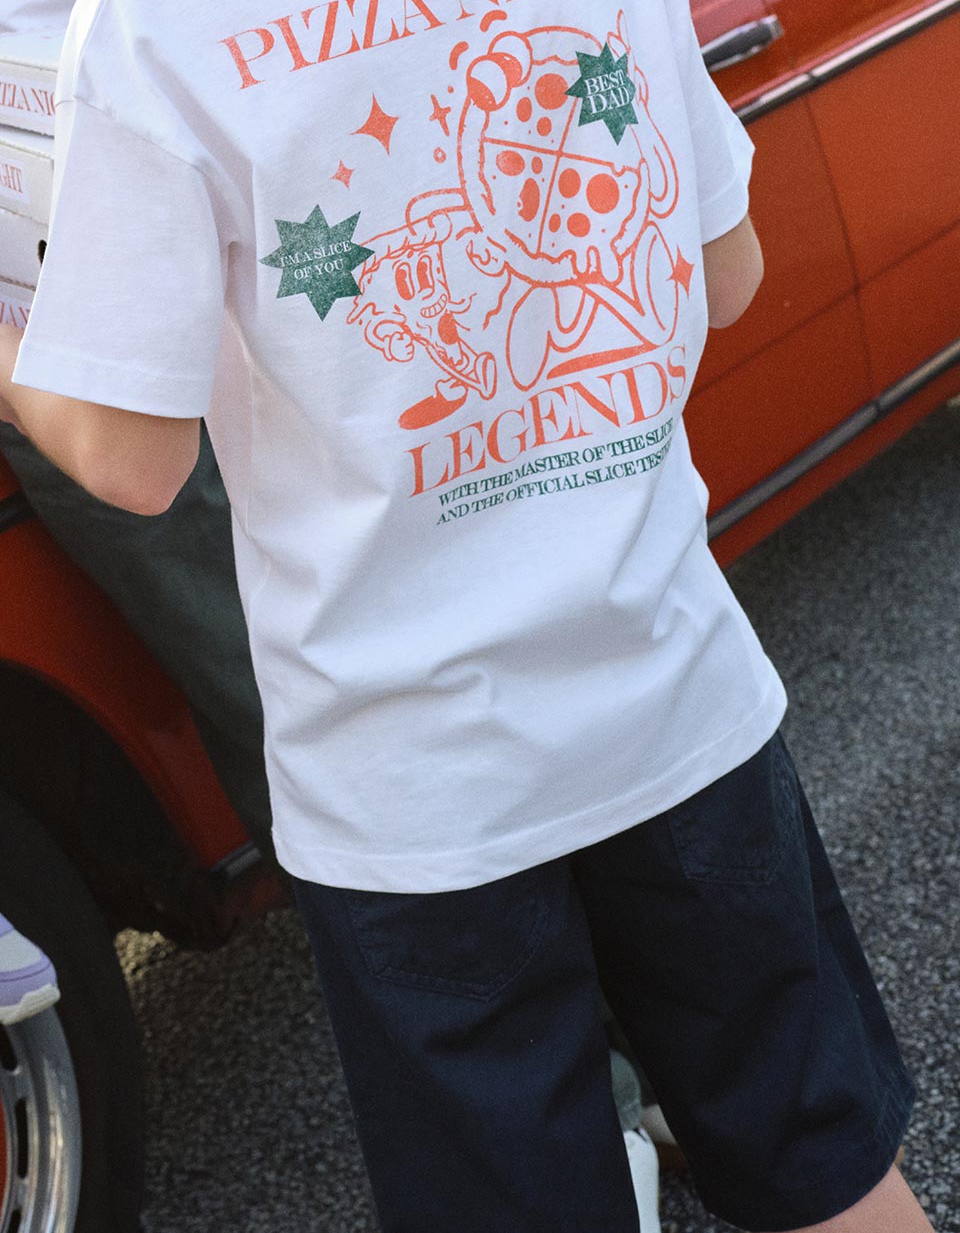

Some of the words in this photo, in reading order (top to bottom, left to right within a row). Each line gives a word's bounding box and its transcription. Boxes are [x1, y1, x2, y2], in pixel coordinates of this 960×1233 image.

[584, 69, 625, 95] BEST
[586, 87, 630, 114] DAD
[313, 240, 352, 259] SLICE
[293, 266, 312, 280] OF
[314, 258, 345, 276] YOU
[408, 345, 686, 498] LEGENDS
[437, 480, 480, 507] WITH
[480, 470, 514, 493] THE
[514, 449, 581, 482] MASTER
[581, 445, 606, 464] OF
[606, 434, 646, 458] THE
[435, 502, 470, 526] AND
[470, 491, 504, 514] THE
[505, 470, 585, 503] OFFICIAL
[584, 460, 638, 486] SLICE
